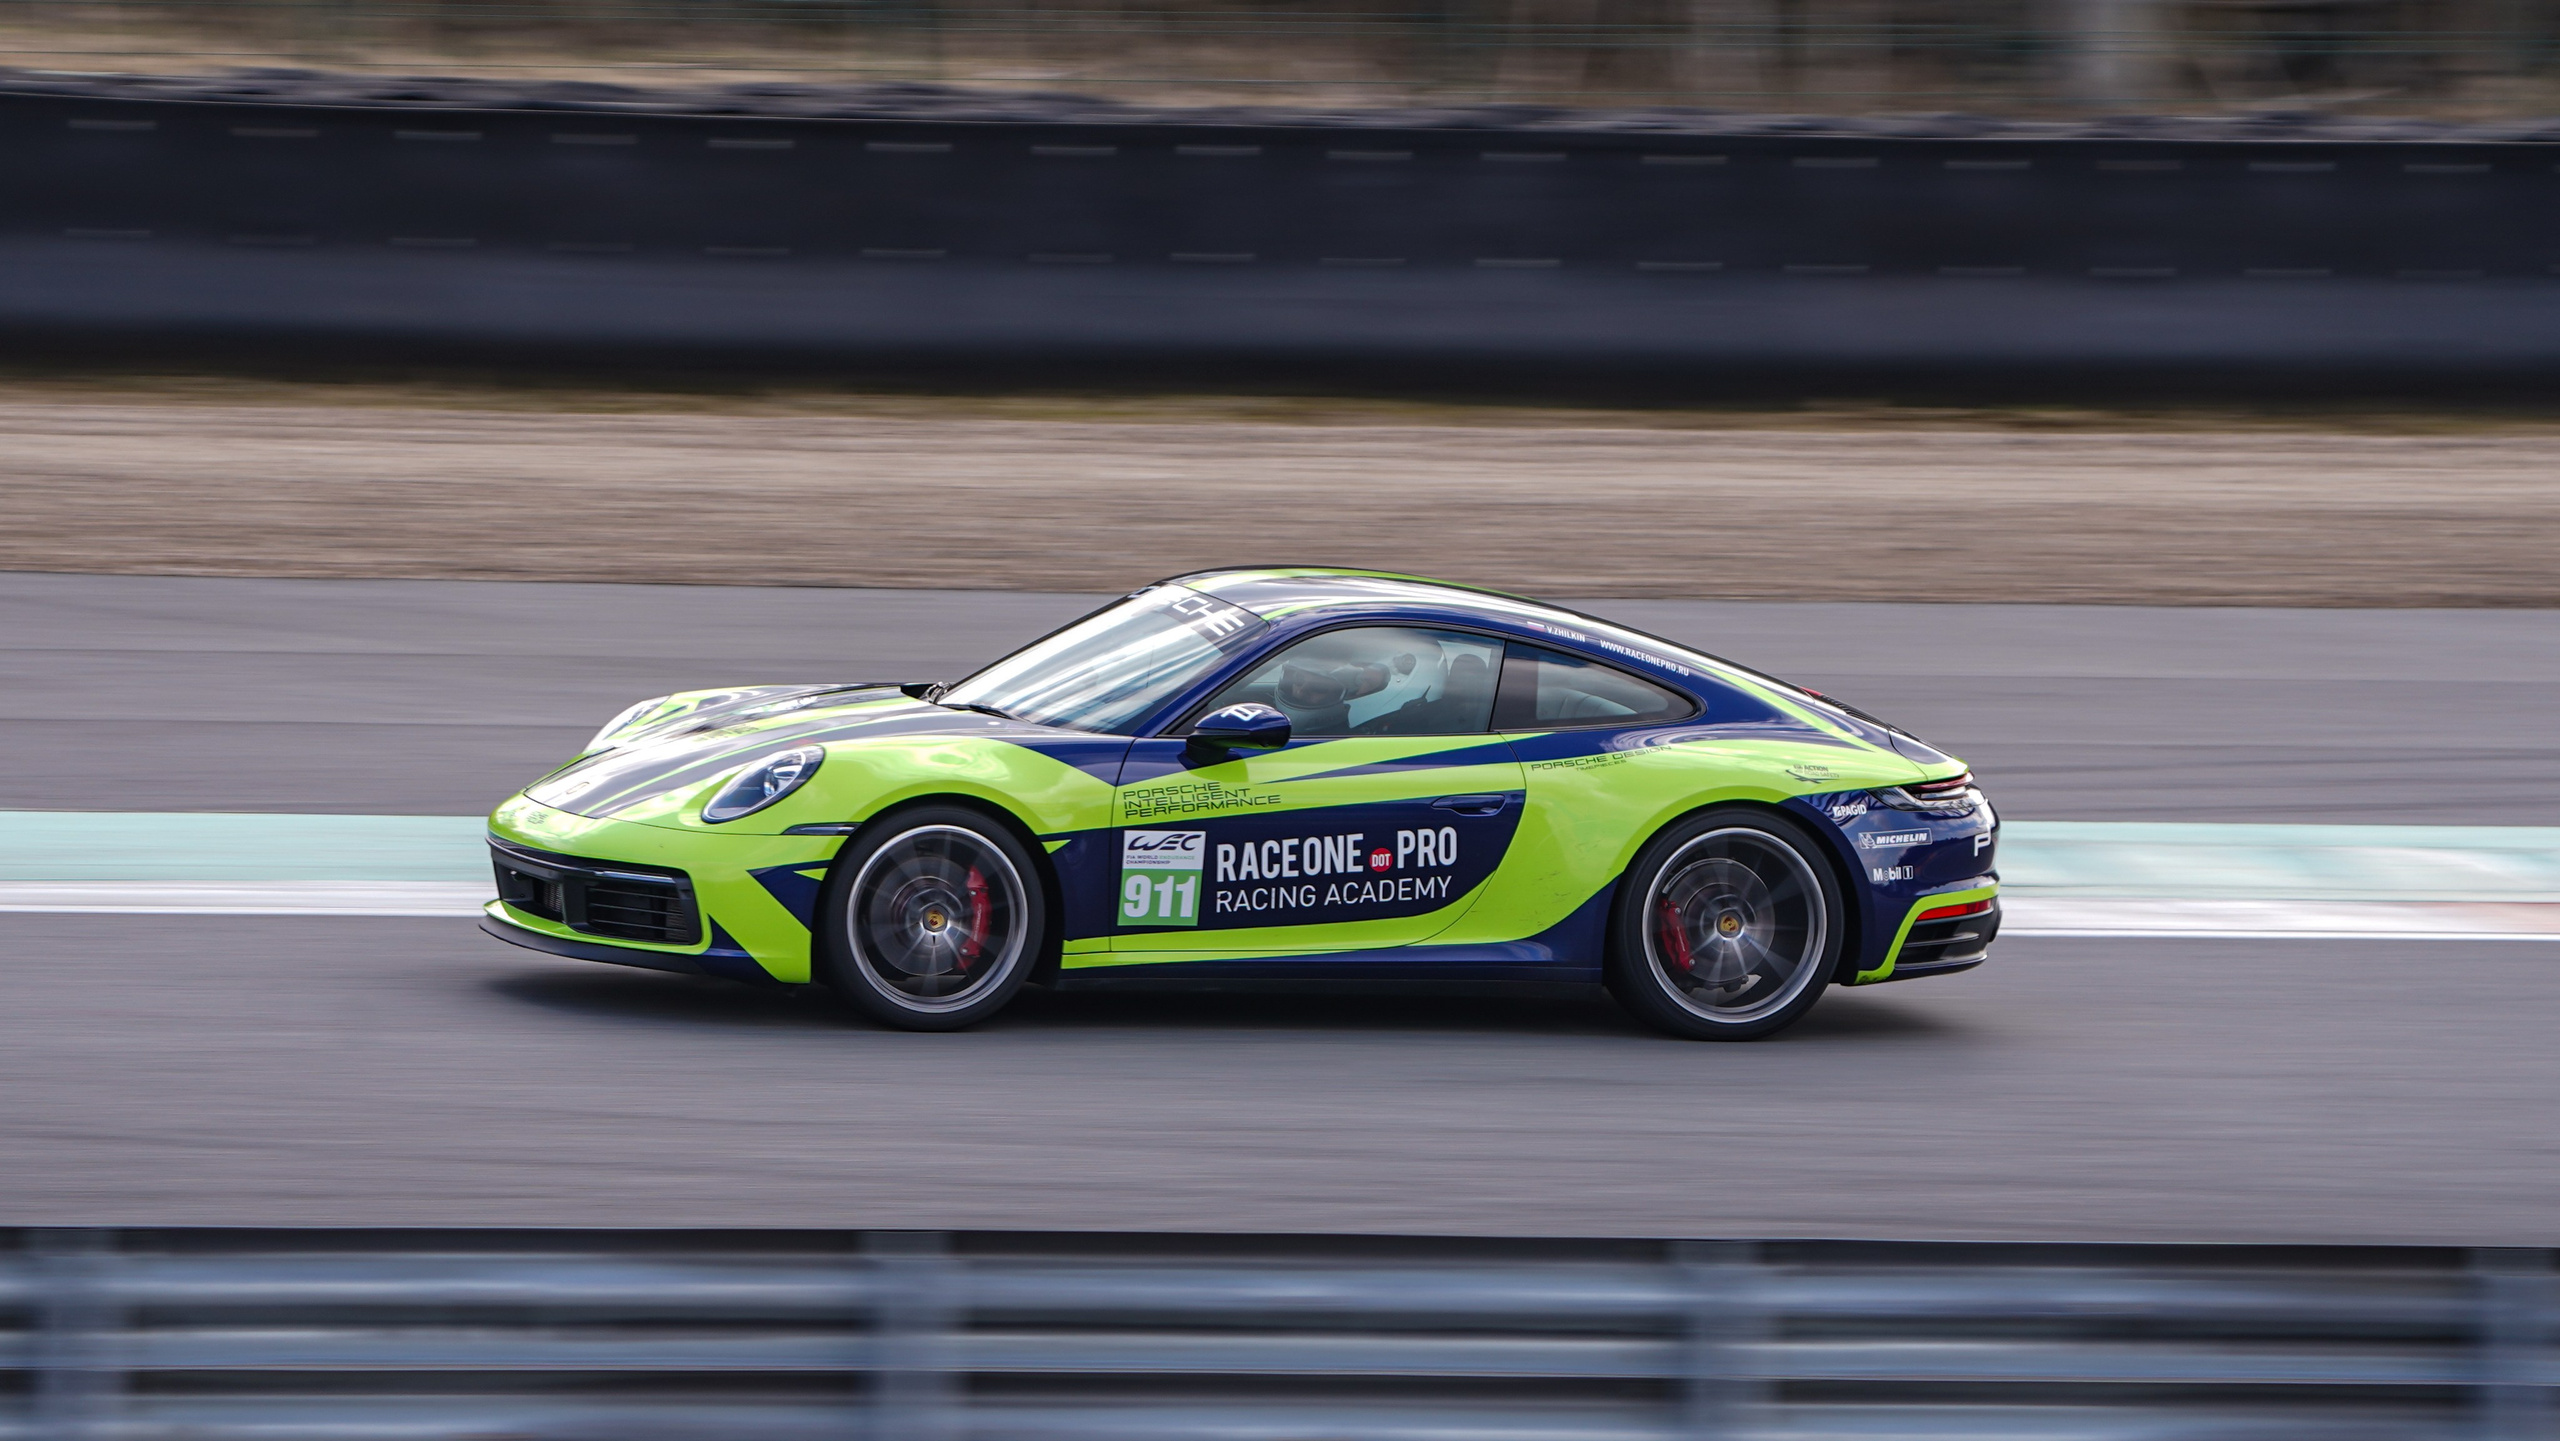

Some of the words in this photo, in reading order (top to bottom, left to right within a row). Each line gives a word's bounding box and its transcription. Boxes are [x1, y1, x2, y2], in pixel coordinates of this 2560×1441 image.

[1547, 626, 1586, 643] V.ZHILKIN
[1600, 640, 1689, 677] WWW.RACEONEPRO.RU
[1531, 756, 1607, 771] PORSCHE
[1612, 745, 1672, 760] DESIGN
[1123, 782, 1221, 800] PORSCHE
[1124, 788, 1250, 810] INTELLIGENT
[1125, 794, 1282, 819] PERFORMANCE
[1840, 804, 1867, 816] PAGID
[1127, 833, 1202, 851] WEC
[1371, 853, 1391, 867] DOT
[1397, 826, 1457, 869] PRO
[1876, 833, 1928, 845] MICHELIN
[1873, 866, 1902, 881] Mobil
[1123, 874, 1197, 918] 911
[1216, 885, 1316, 913] RACING
[1324, 875, 1452, 906] ACADEMY
